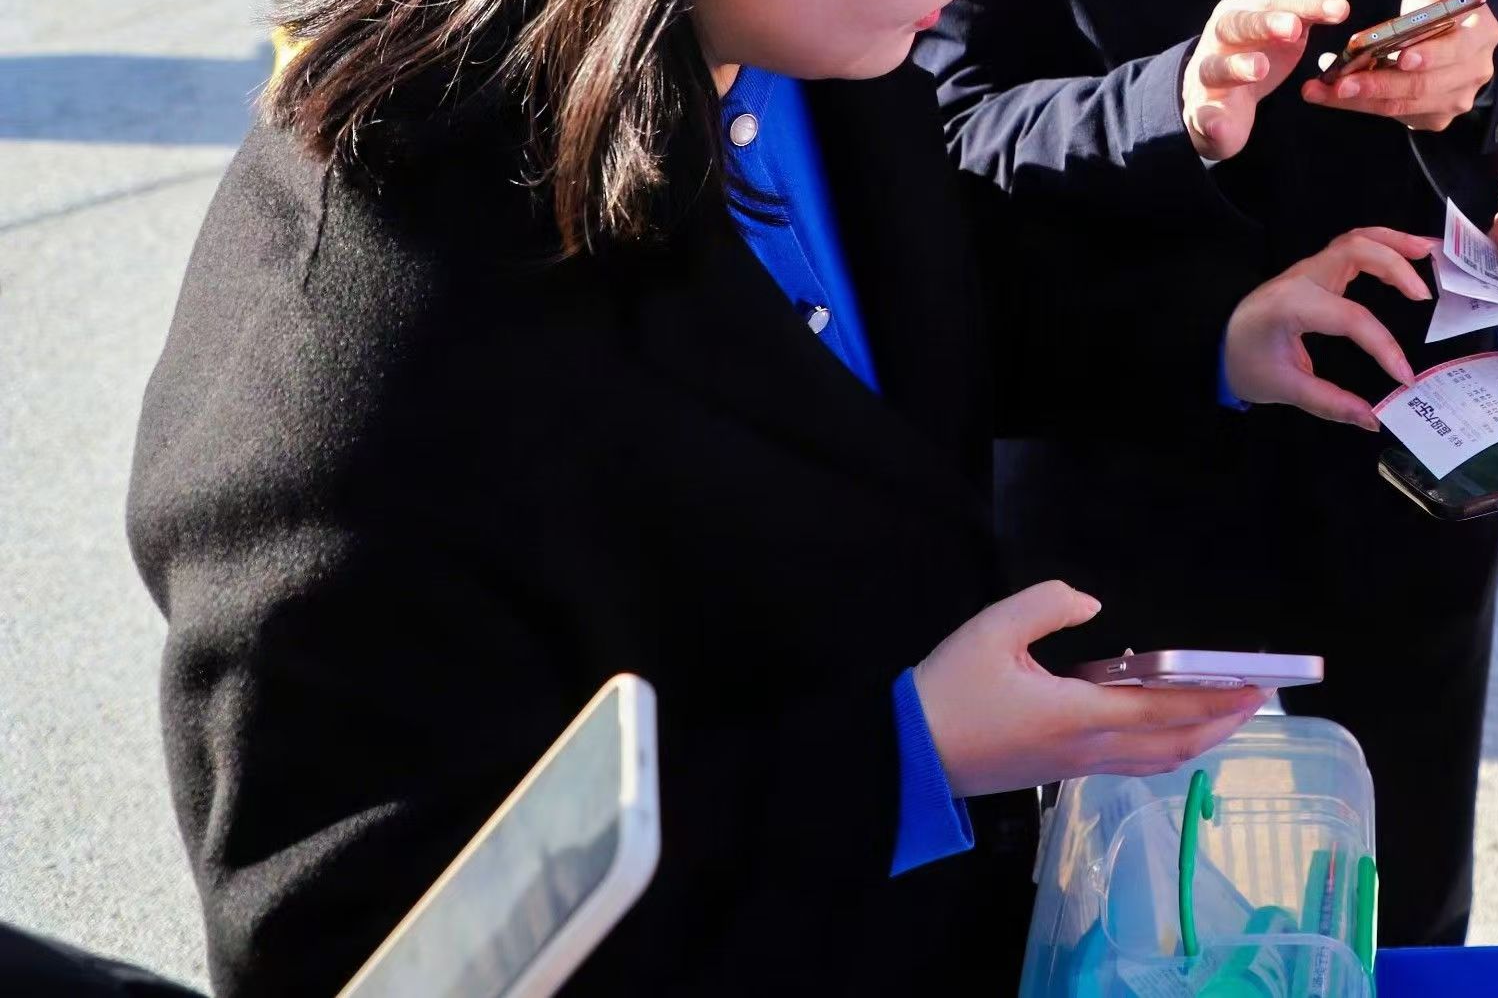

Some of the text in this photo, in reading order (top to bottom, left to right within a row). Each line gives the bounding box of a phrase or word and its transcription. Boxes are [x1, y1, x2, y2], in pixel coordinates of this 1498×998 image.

[1407, 397, 1451, 437] 超级大乐透
